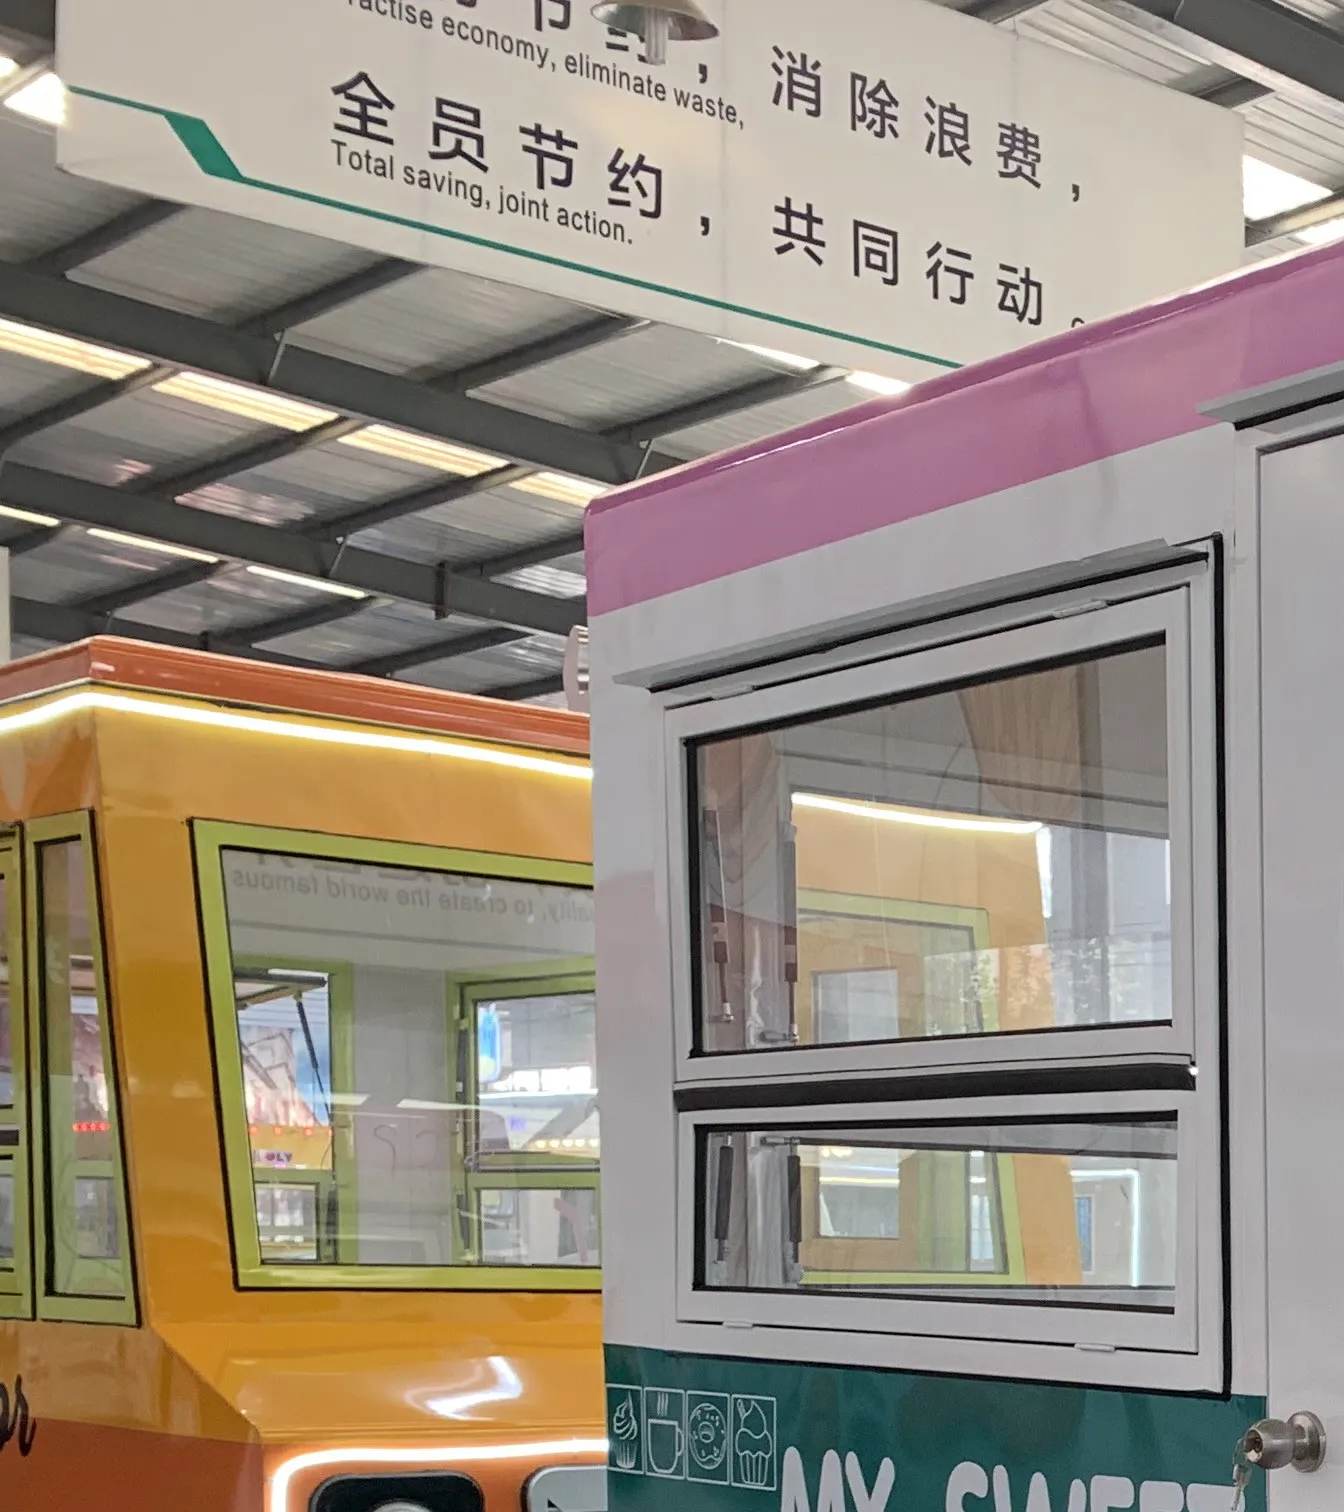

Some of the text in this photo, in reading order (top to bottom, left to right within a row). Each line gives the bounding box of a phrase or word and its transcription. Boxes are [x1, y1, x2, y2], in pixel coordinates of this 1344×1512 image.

[441, 15, 556, 72] economy,
[564, 52, 667, 102] eliminate
[673, 87, 745, 130] waste,
[330, 138, 634, 245] Total saving, joint action.
